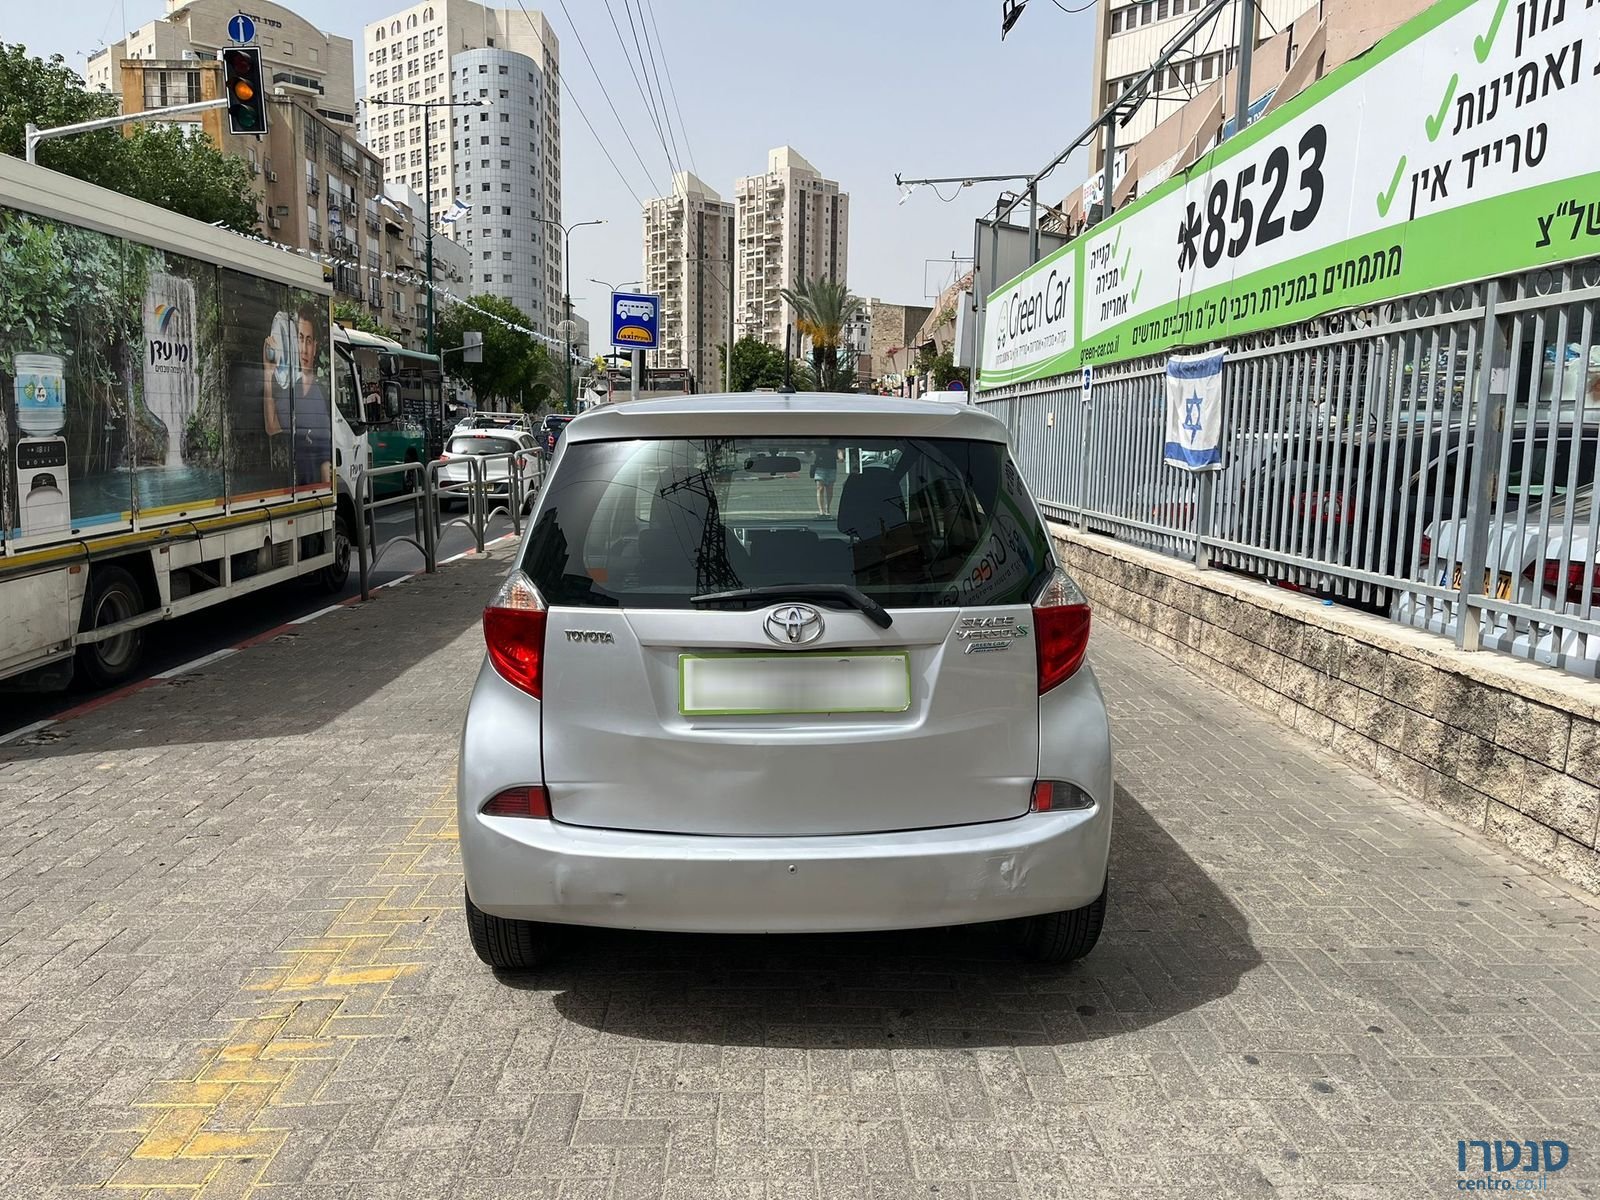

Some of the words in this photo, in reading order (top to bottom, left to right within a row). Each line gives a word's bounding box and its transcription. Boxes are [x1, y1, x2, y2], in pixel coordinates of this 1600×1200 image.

[1453, 38, 1583, 136] ואמינות
[1462, 122, 1548, 189] טרייד
[1409, 159, 1452, 221] אין
[1090, 243, 1110, 269] קנייה
[1323, 245, 1402, 295] מתמחים
[1096, 268, 1118, 295] מכירה
[1260, 272, 1317, 313] במכירת
[1009, 291, 1043, 340] Green
[1045, 269, 1071, 324] Car
[1101, 293, 1128, 321] אחריות
[1231, 292, 1257, 320] רכבי
[1132, 320, 1160, 345] חדשים
[1162, 310, 1193, 338] ורכבים
[150, 340, 173, 366] עדן
[174, 342, 188, 362] מי
[1080, 335, 1120, 365] green-car.co.il
[960, 616, 1015, 628] SPACE
[564, 629, 616, 644] TOYOTA
